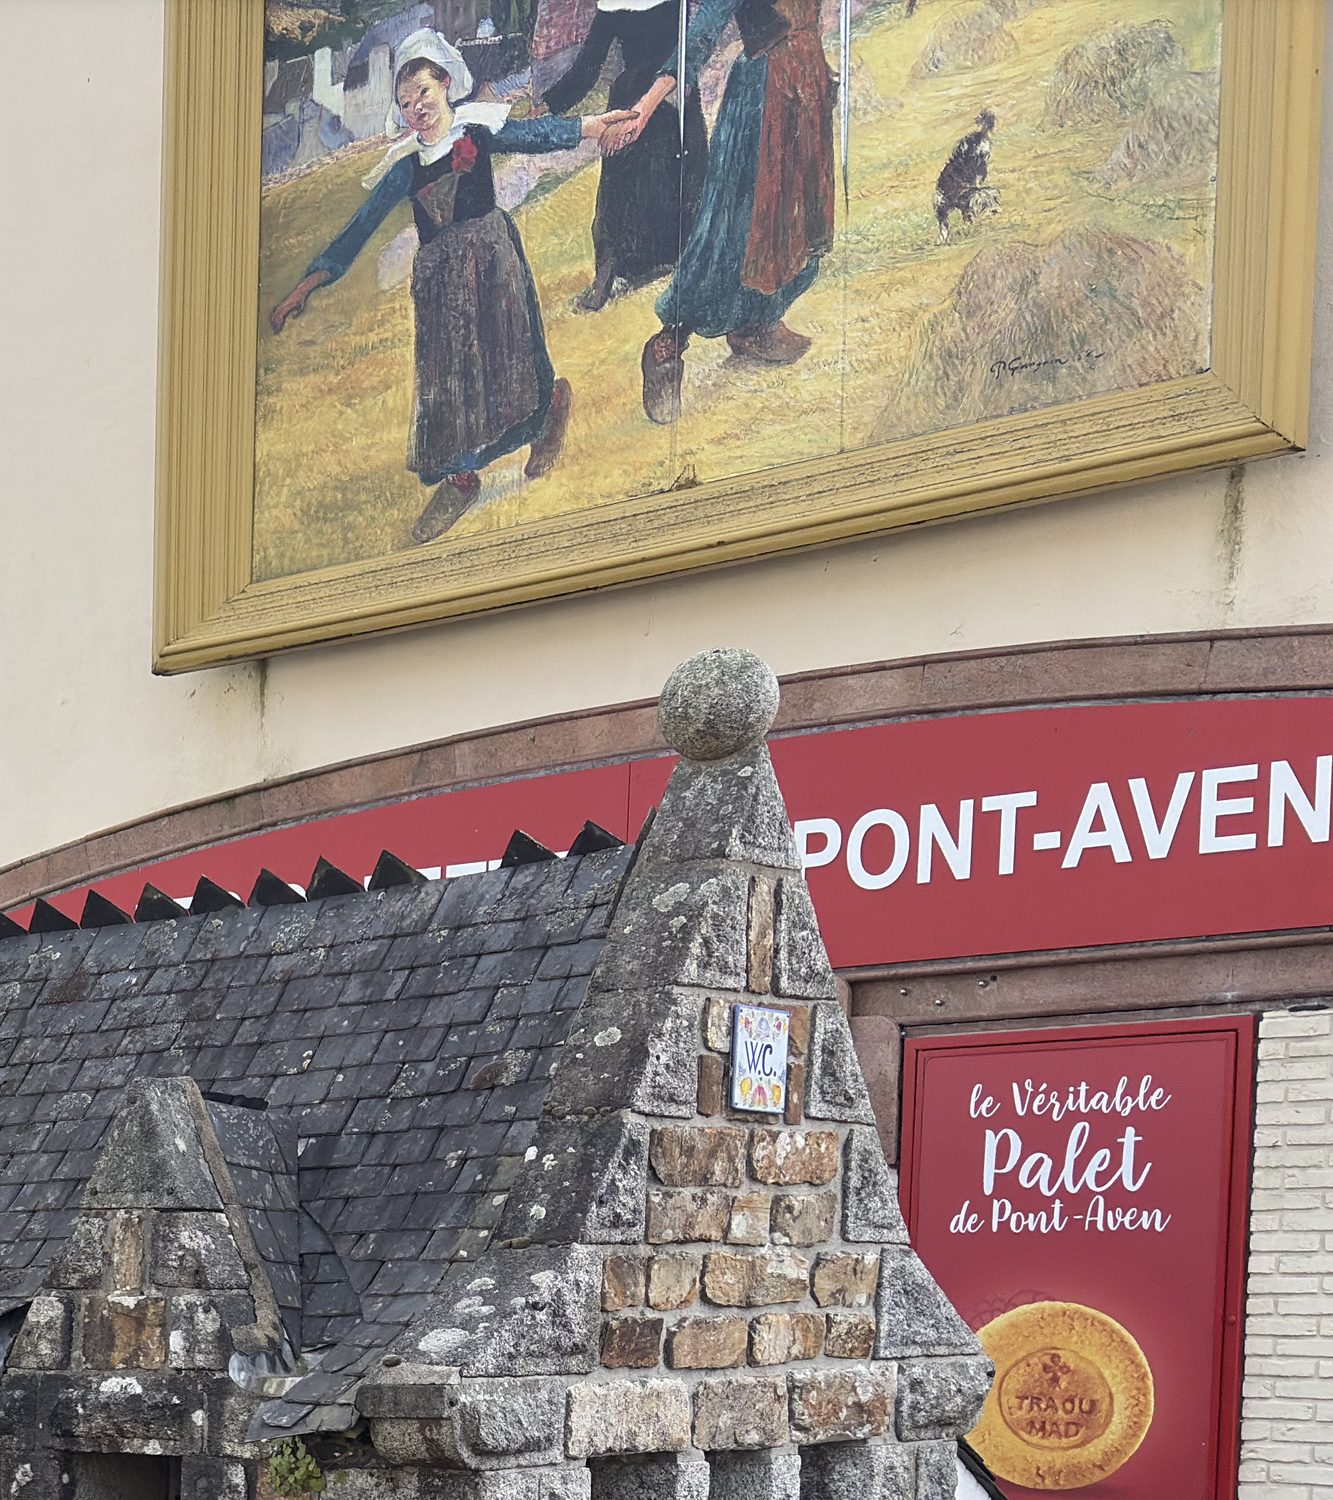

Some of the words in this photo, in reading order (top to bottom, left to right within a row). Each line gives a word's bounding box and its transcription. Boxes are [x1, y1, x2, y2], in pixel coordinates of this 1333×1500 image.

[793, 754, 1332, 891] PONT-AVEN
[744, 1040, 777, 1078] W.C.
[969, 1083, 1001, 1119] le
[1012, 1074, 1173, 1122] Véritable
[982, 1121, 1153, 1197] Palet
[949, 1200, 985, 1234] de
[1014, 1394, 1100, 1416] TRAOU
[1025, 1420, 1085, 1440] MAD
